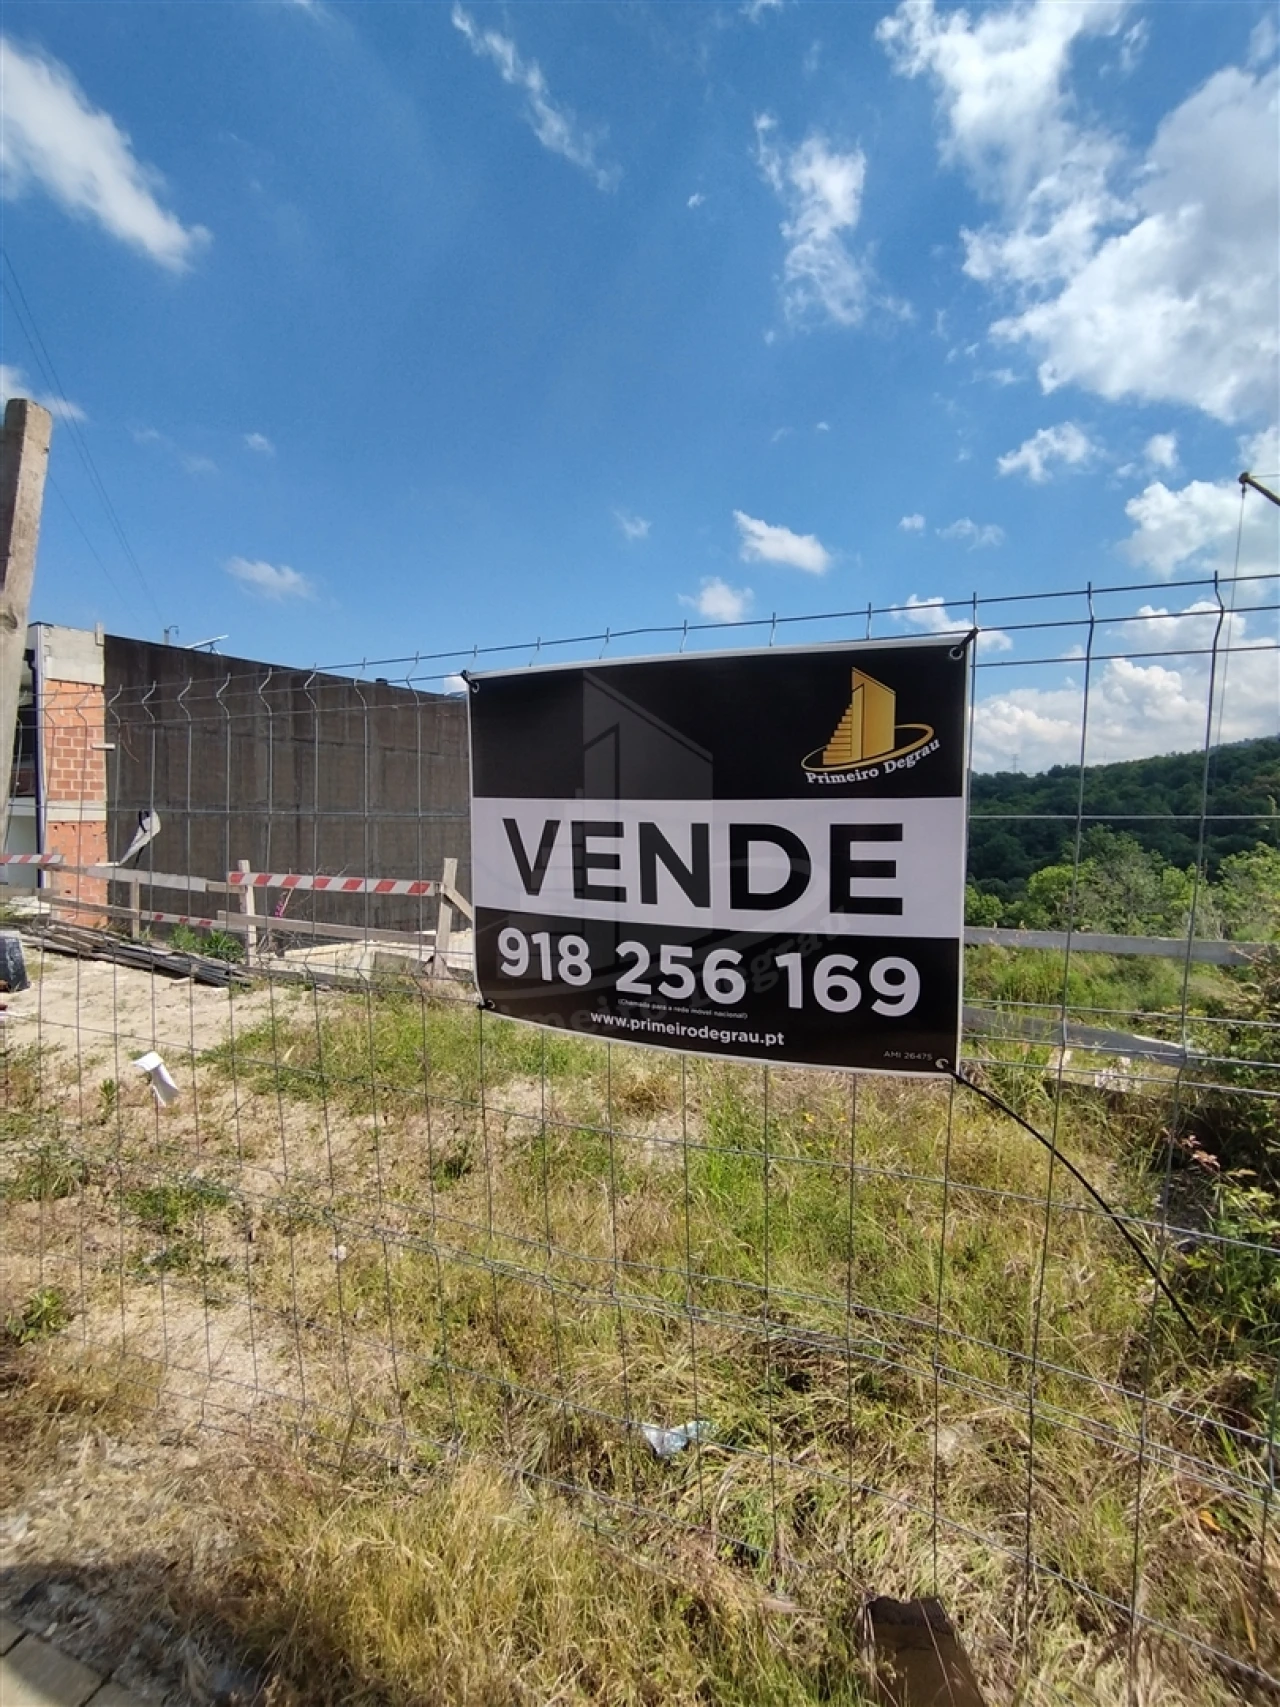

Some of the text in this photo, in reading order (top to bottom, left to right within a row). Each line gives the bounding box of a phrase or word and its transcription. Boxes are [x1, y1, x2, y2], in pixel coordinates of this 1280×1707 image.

[805, 739, 941, 784] Primeiro Degrau
[502, 818, 904, 916] VENDE
[498, 927, 921, 1018] 918 256 169
[591, 1012, 785, 1046] www.primeirodegrau.pt
